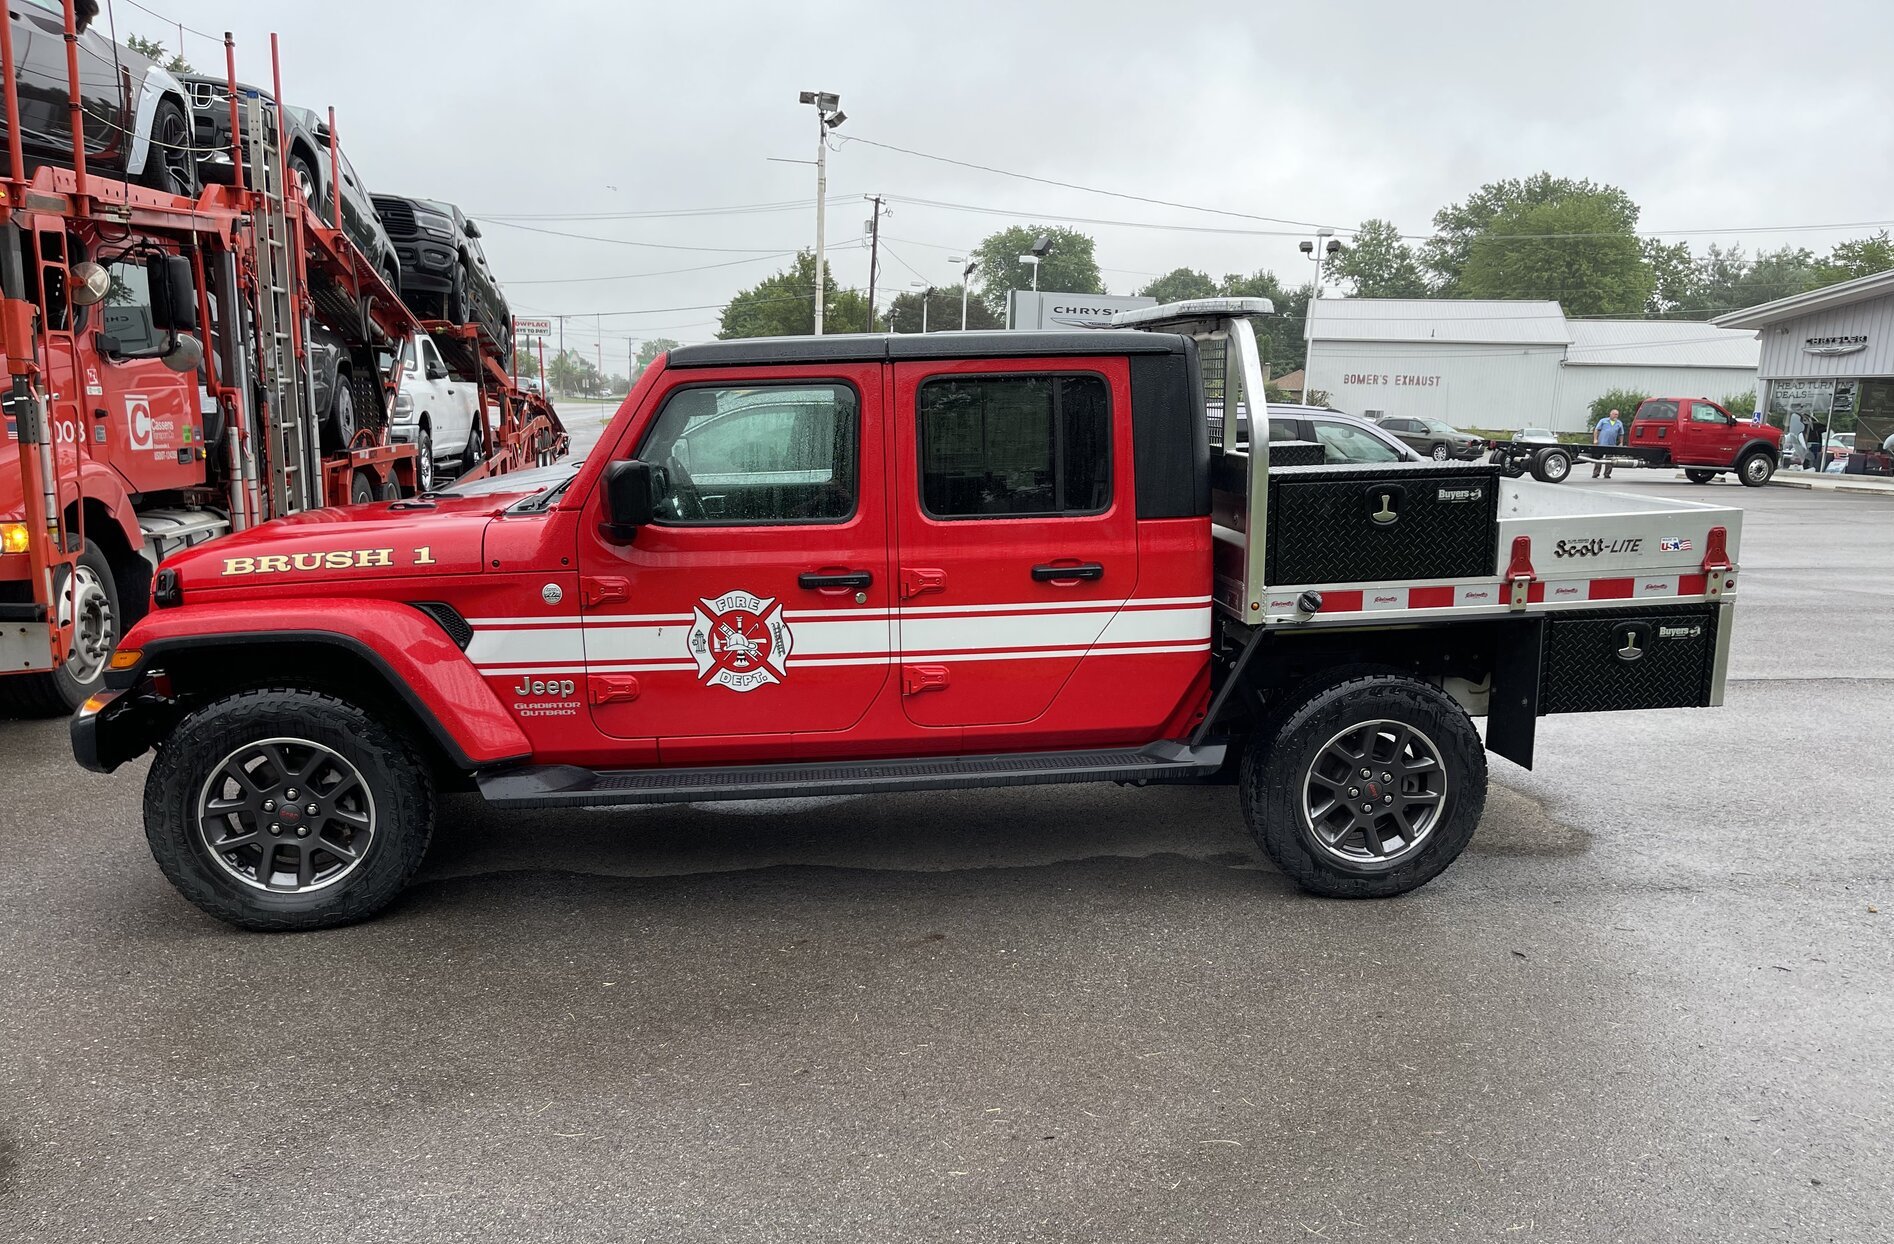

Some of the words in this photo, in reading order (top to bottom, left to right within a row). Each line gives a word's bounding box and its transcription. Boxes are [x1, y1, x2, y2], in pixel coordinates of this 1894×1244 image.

[1053, 306, 1132, 316] CHRYS
[1343, 374, 1389, 385] BOMER'S
[1395, 375, 1441, 386] EXHAUST
[1777, 382, 1806, 390] HEAD
[1776, 391, 1807, 399] DEALS
[1438, 489, 1469, 500] Buyers
[1661, 542, 1680, 550] USA
[221, 548, 394, 576] BRUSH
[413, 546, 436, 565] 1
[716, 596, 760, 612] FIRE
[1659, 626, 1689, 637] Buyers
[720, 671, 768, 686] DEPT.
[514, 676, 575, 699] Jeep
[514, 701, 581, 710] GLADIATOR
[520, 709, 576, 717] OUTBACK
